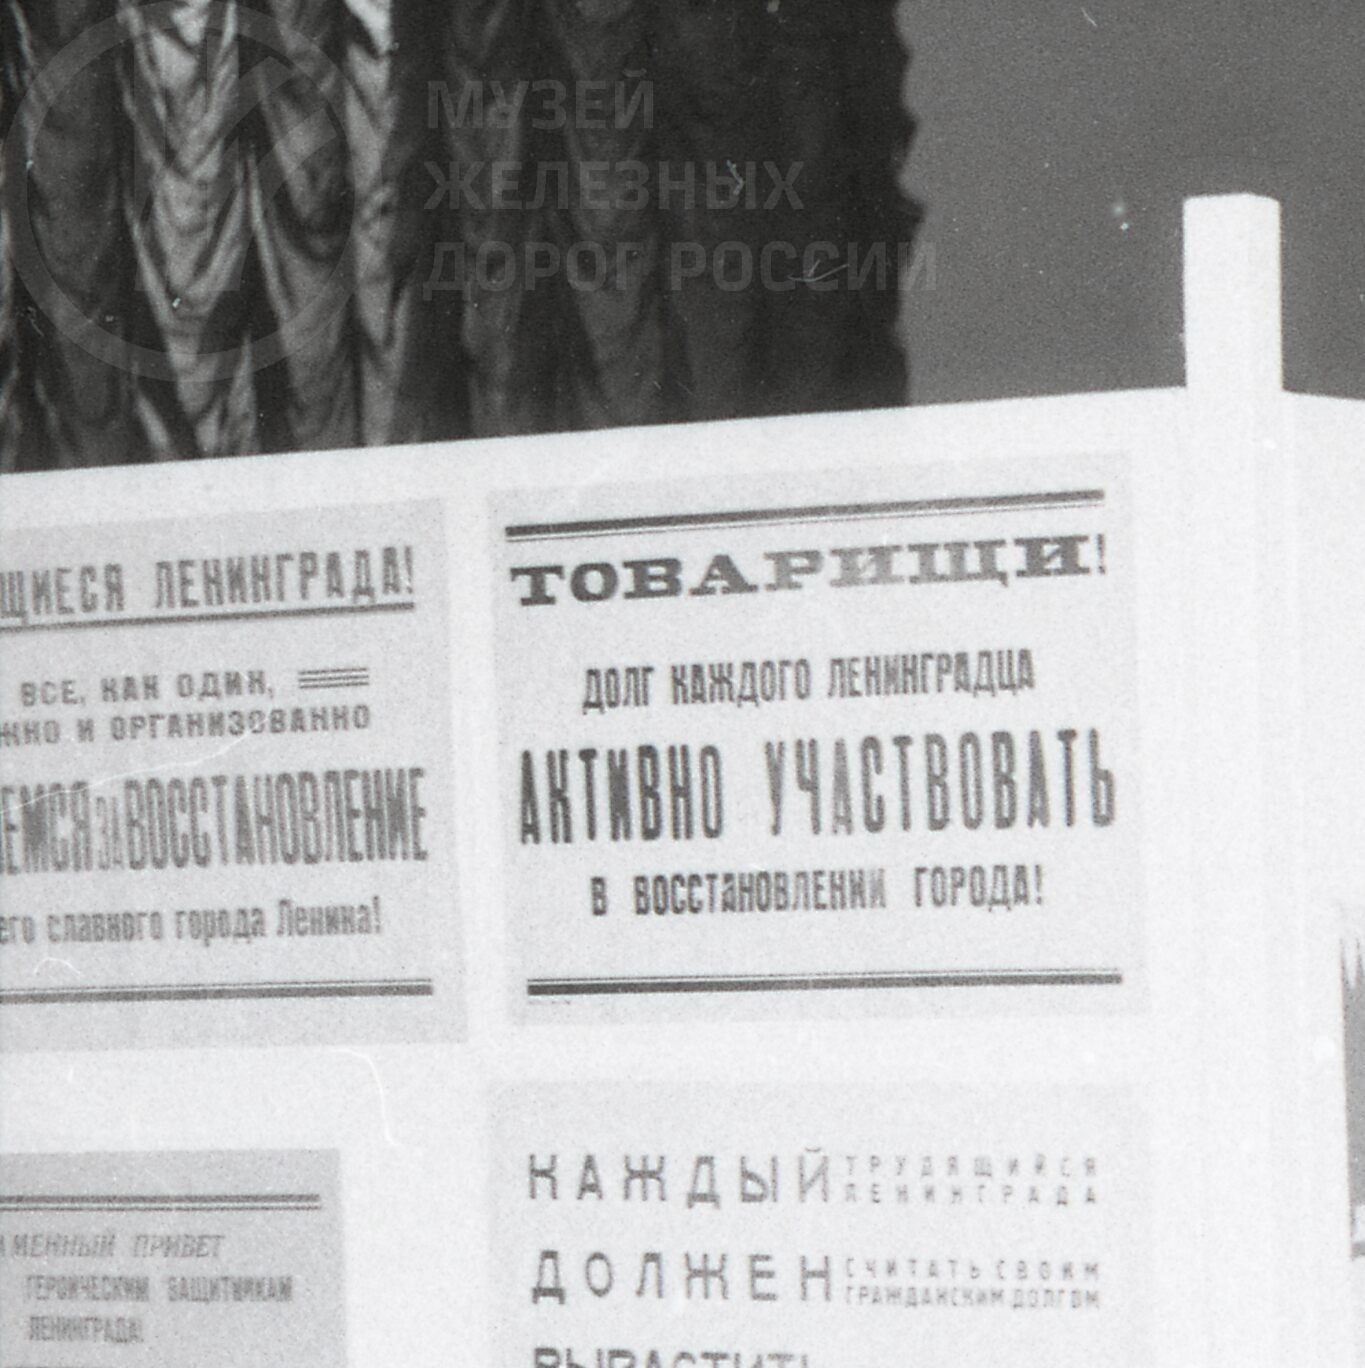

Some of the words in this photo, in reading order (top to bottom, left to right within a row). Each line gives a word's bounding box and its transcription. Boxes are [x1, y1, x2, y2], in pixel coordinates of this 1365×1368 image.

[155, 545, 414, 608] ЛЕНИНГРАДА!
[510, 533, 1106, 606] ТОВАРИЩИ!
[103, 673, 159, 701] КАК
[178, 669, 274, 700] ОДИН,
[583, 665, 654, 714] ДОЛГ
[671, 659, 810, 708] КАЖДОГО
[828, 649, 1035, 699] ЛЕНИНГРАДЦА
[79, 718, 94, 742] И
[111, 705, 370, 741] ОРГАНИЗОВАННО
[519, 744, 722, 844] АКТИВНО
[765, 728, 1116, 836] УЧАСТВОВАТЬ
[124, 767, 428, 871] ВОССТАНОВЛЕНИЕ
[591, 875, 608, 916] В
[635, 868, 886, 915] ВОССТАНОВЛЕНИИ
[915, 864, 1044, 911] ГОРОДА!
[47, 910, 163, 943] славного
[175, 907, 266, 947] города
[277, 897, 381, 935] Ленина!
[528, 1148, 831, 1208] КАЖДЫЙ
[846, 1152, 1097, 1177] ТРУДЯЩИЙСЯ
[846, 1183, 1097, 1205] ЛЕНИНГРАДА
[133, 1235, 225, 1258] ПРИВЕТ
[846, 1257, 981, 1279] СЧИТАТЬ
[996, 1258, 1100, 1280] СВОИМ
[532, 1250, 832, 1304] ДОЛЖЕН
[846, 1286, 1003, 1309] ГРАЖДАНСКИМ
[1011, 1287, 1100, 1309] ДОЛГОМ
